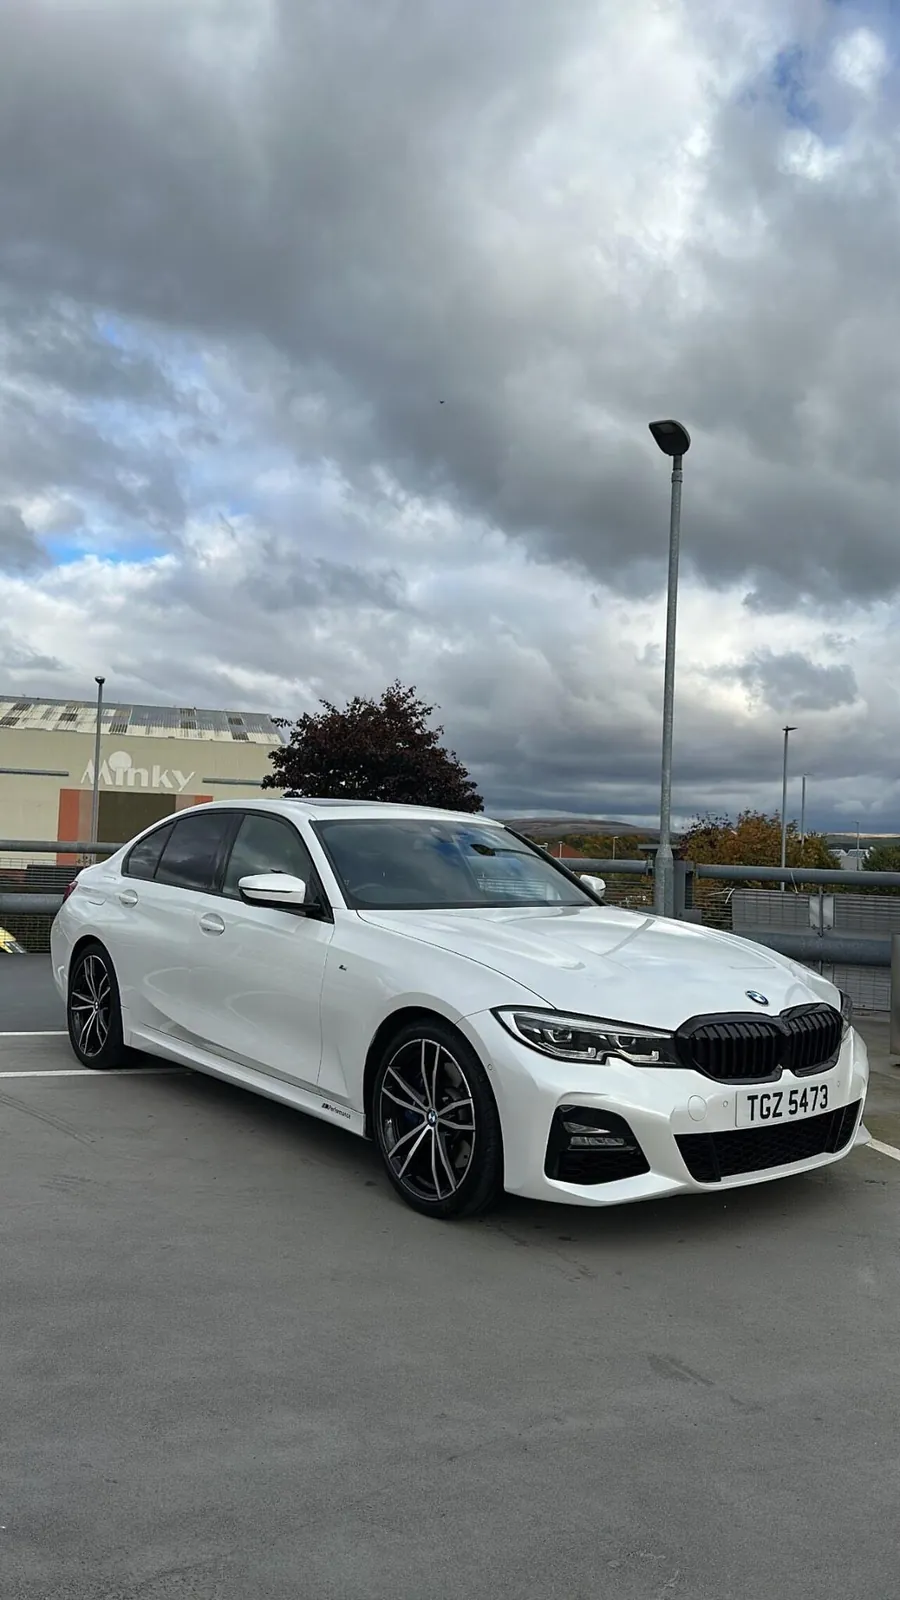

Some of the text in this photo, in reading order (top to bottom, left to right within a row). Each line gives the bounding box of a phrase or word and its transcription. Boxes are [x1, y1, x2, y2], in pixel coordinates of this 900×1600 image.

[82, 751, 195, 791] Minky
[747, 1085, 828, 1121] TGZ 5473
